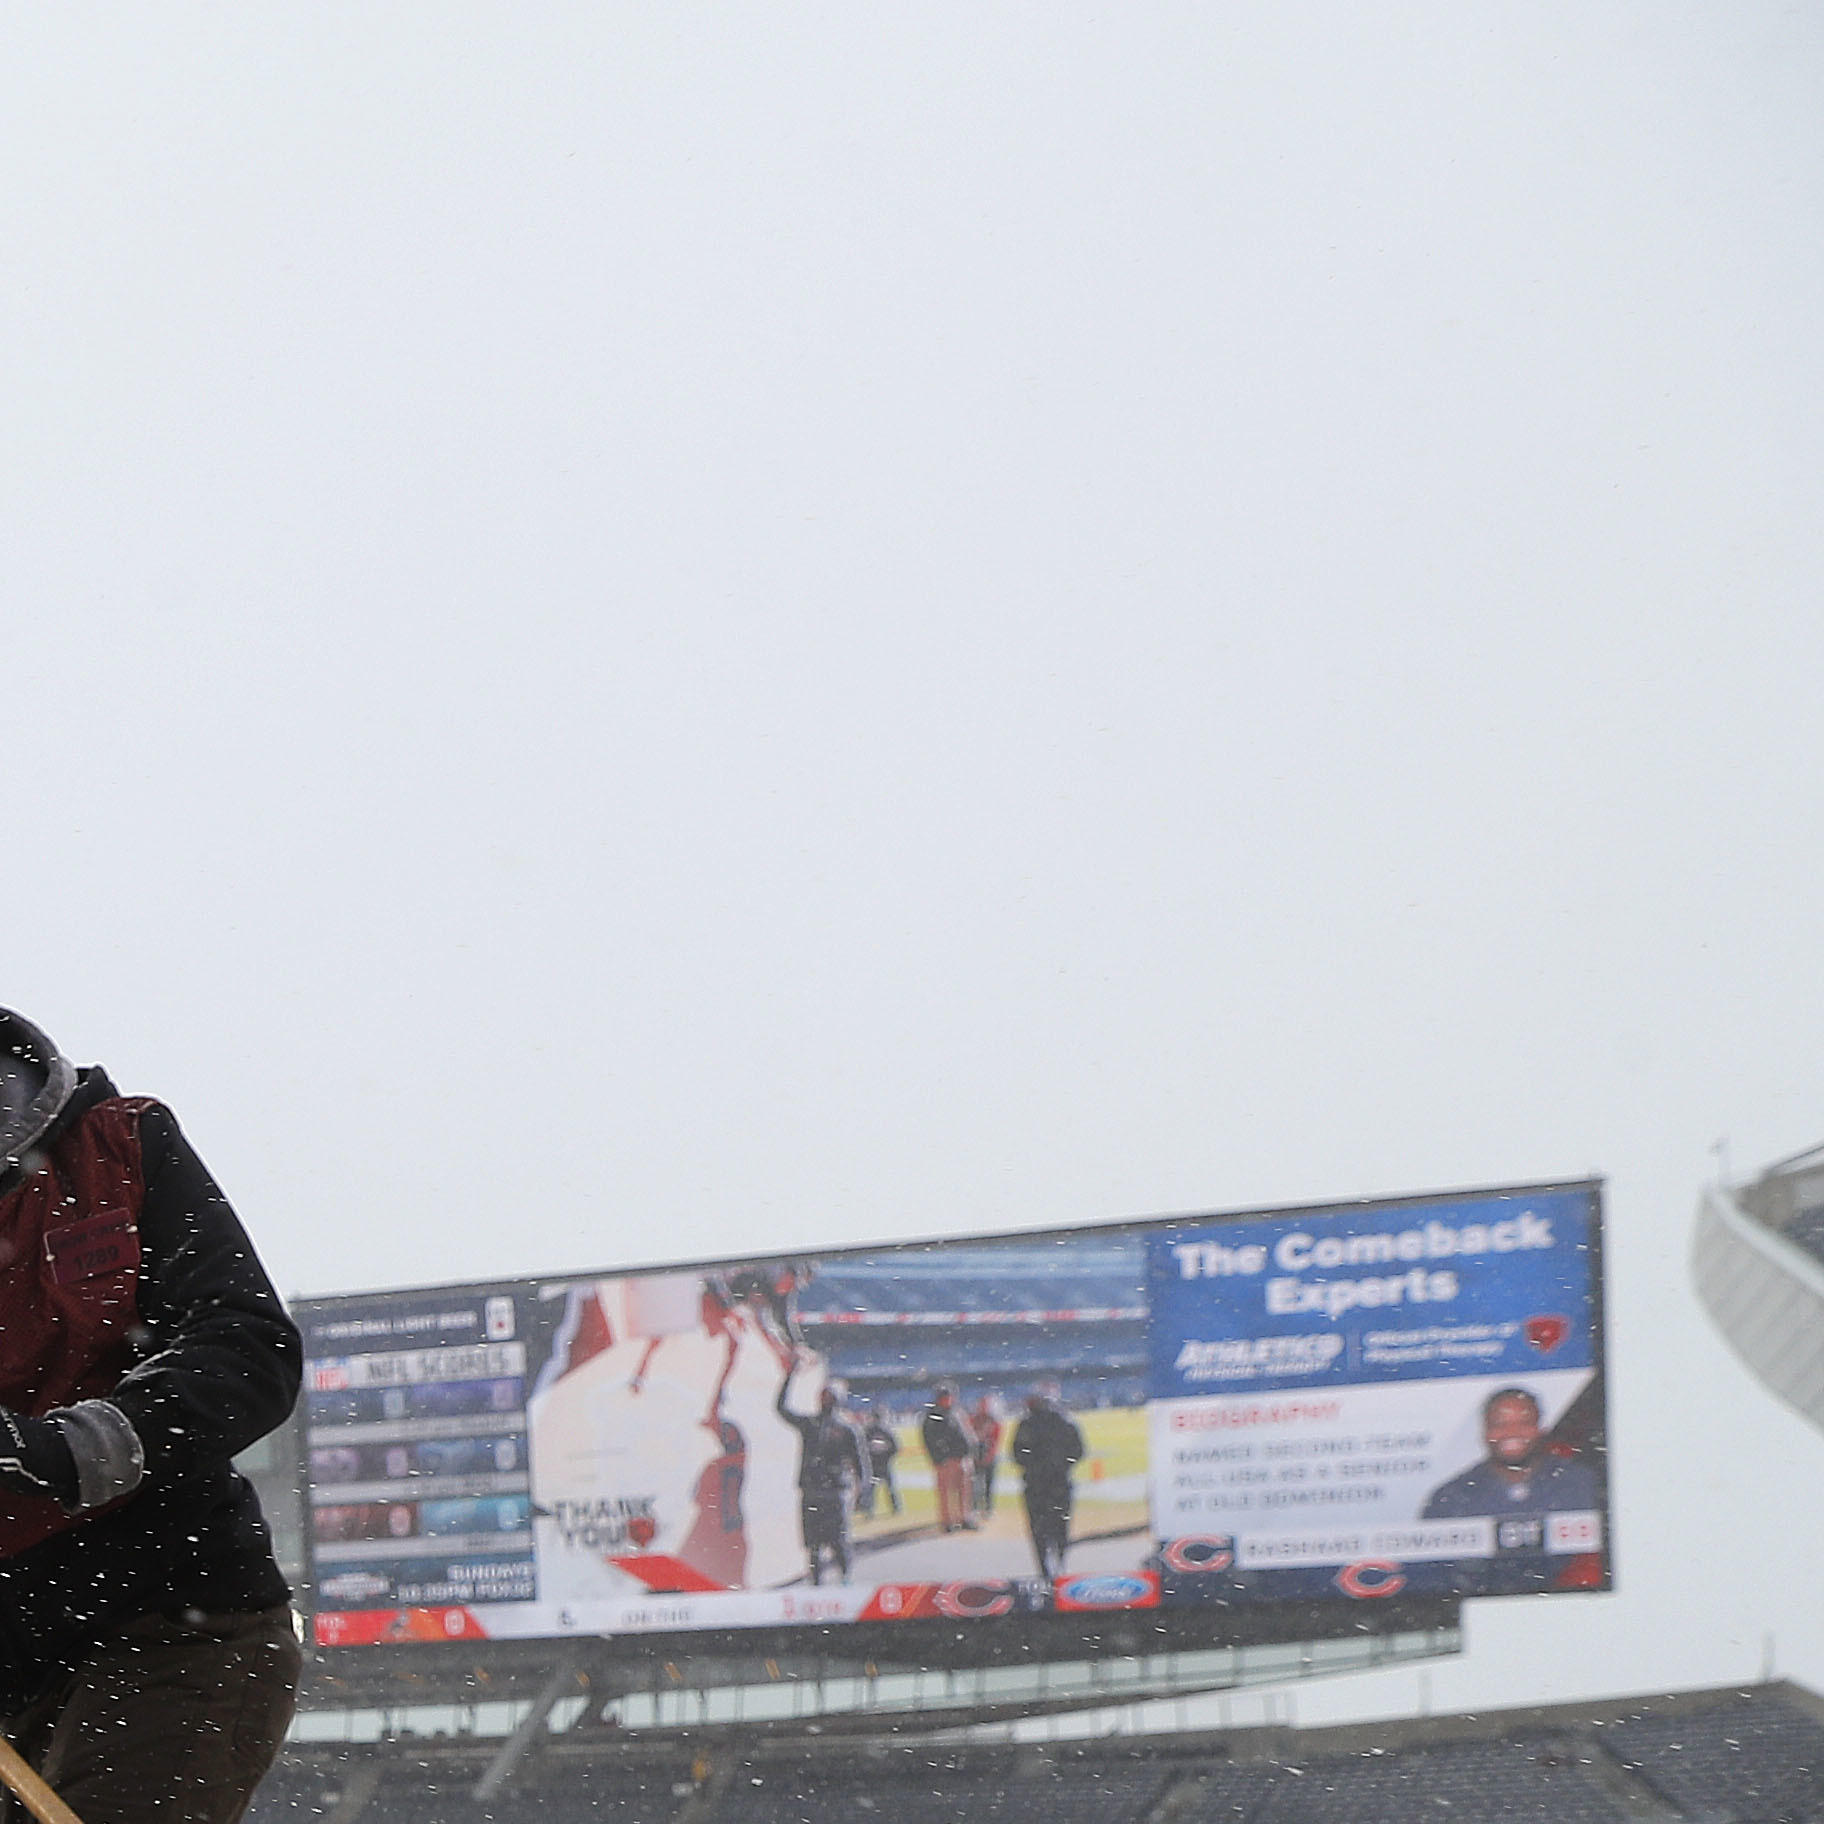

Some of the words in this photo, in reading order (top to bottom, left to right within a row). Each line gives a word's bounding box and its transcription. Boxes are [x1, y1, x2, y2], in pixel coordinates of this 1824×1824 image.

[1172, 1242, 1266, 1280] The
[1275, 1213, 1554, 1272] Comeback
[1265, 1268, 1458, 1321] Experts
[554, 1498, 656, 1519] THANK
[564, 1523, 628, 1547] YOU
